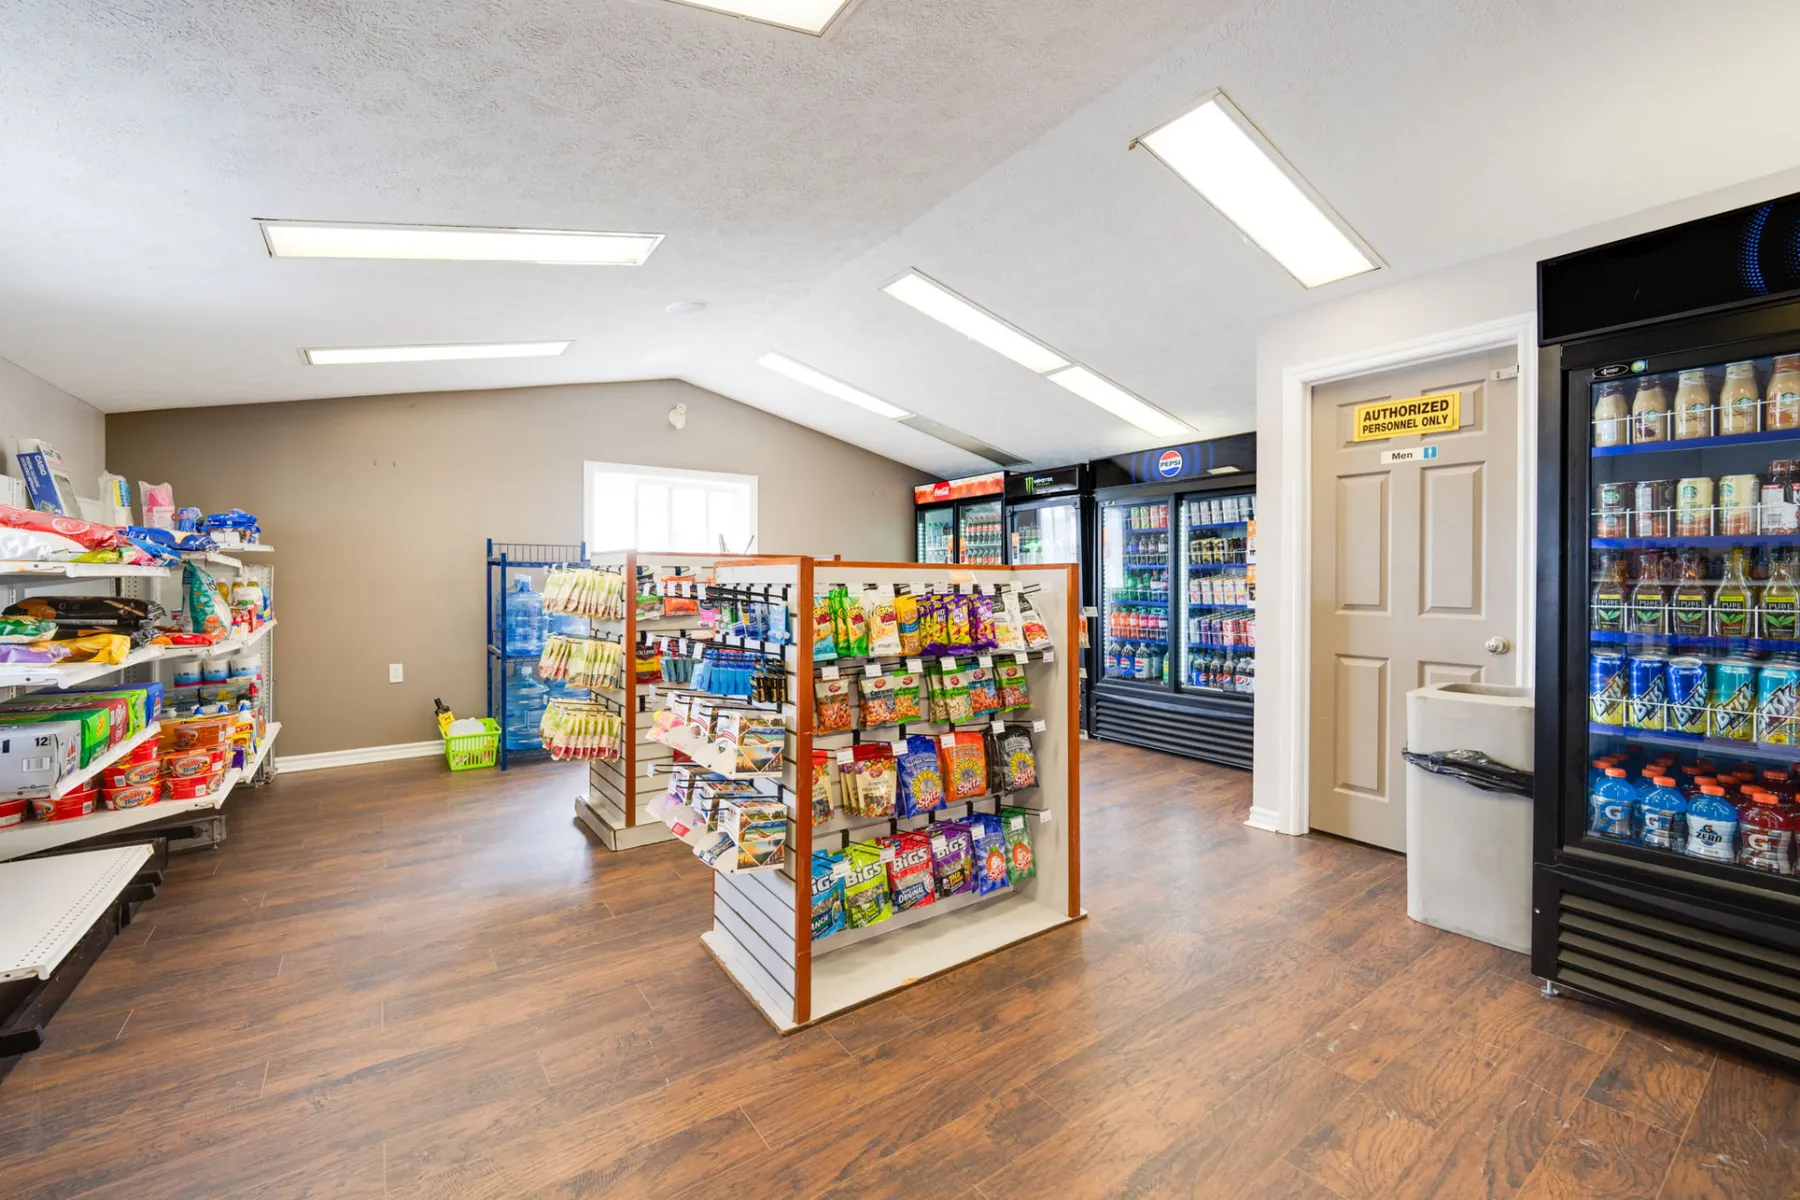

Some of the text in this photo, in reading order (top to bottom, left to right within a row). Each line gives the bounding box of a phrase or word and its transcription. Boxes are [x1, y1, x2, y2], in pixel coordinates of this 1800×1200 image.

[1363, 399, 1449, 422] AUTHORIZED
[1362, 414, 1449, 434] PERSONNEL ONLY
[1391, 451, 1413, 460] Men
[34, 455, 47, 476] CASIO
[1160, 459, 1181, 468] PEPSI
[1768, 602, 1793, 610] PURE
[34, 736, 48, 747] 12
[1013, 768, 1035, 787] Spitz
[956, 777, 982, 795] Spitz
[1695, 831, 1722, 843] ZERO
